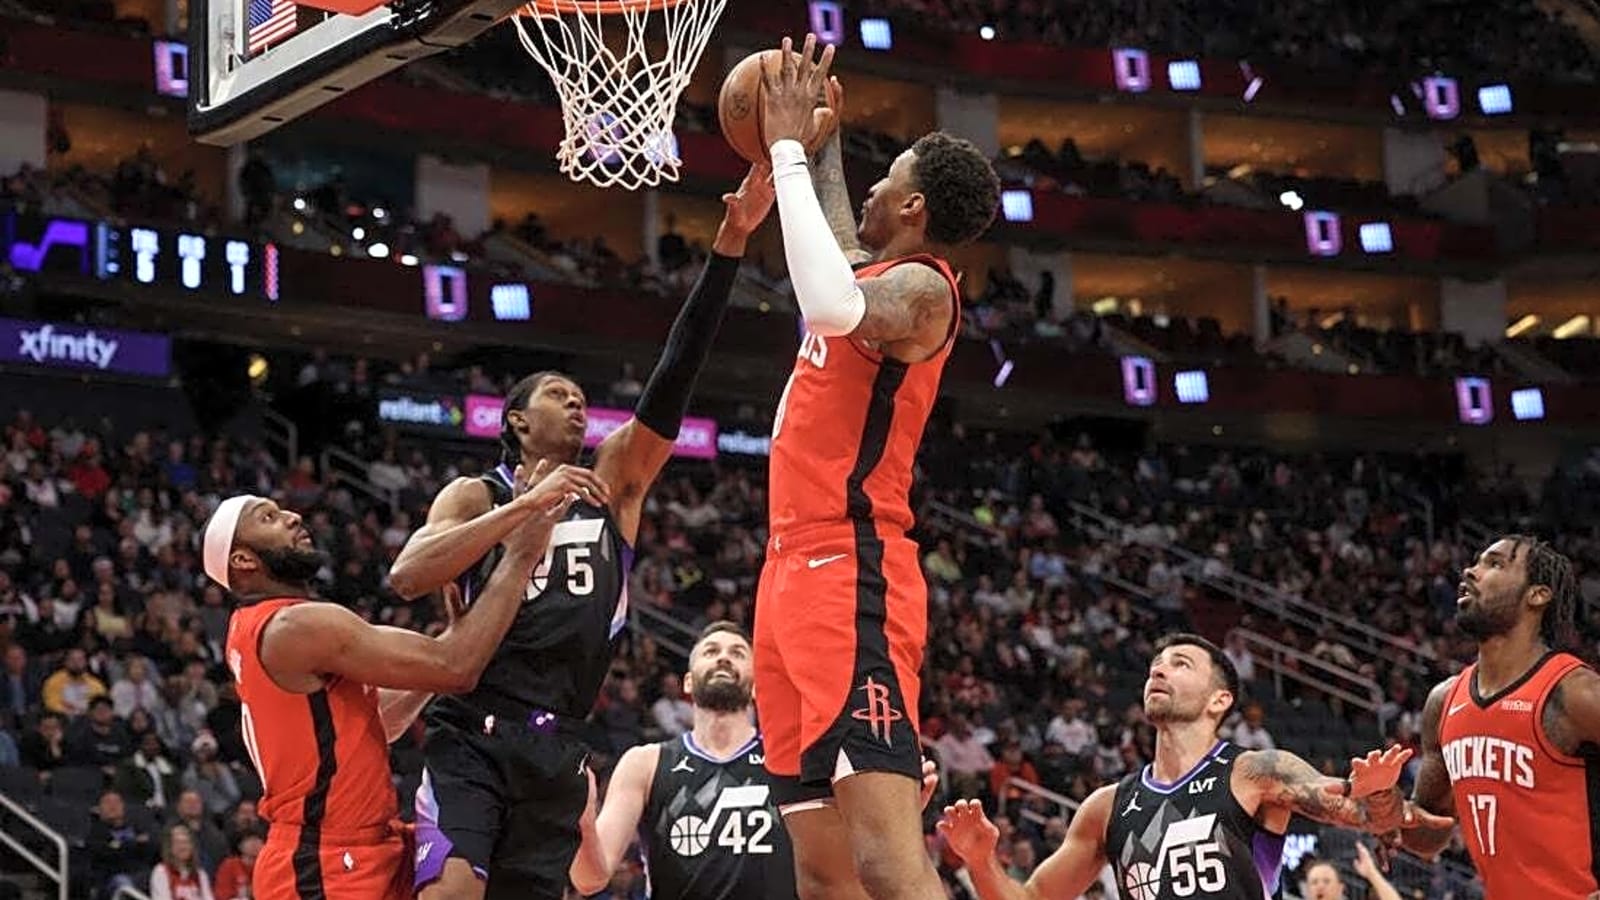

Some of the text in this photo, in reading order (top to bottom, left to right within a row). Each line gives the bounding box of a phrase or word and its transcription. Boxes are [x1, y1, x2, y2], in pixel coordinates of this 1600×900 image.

[19, 324, 118, 368] xfinity
[379, 398, 441, 425] reliant
[566, 547, 595, 596] 5
[748, 753, 766, 765] LV
[1441, 734, 1536, 789] ROCKETS
[1187, 776, 1218, 794] LVT
[717, 810, 773, 854] 42
[1466, 794, 1497, 857] 17
[1167, 842, 1226, 898] 55
